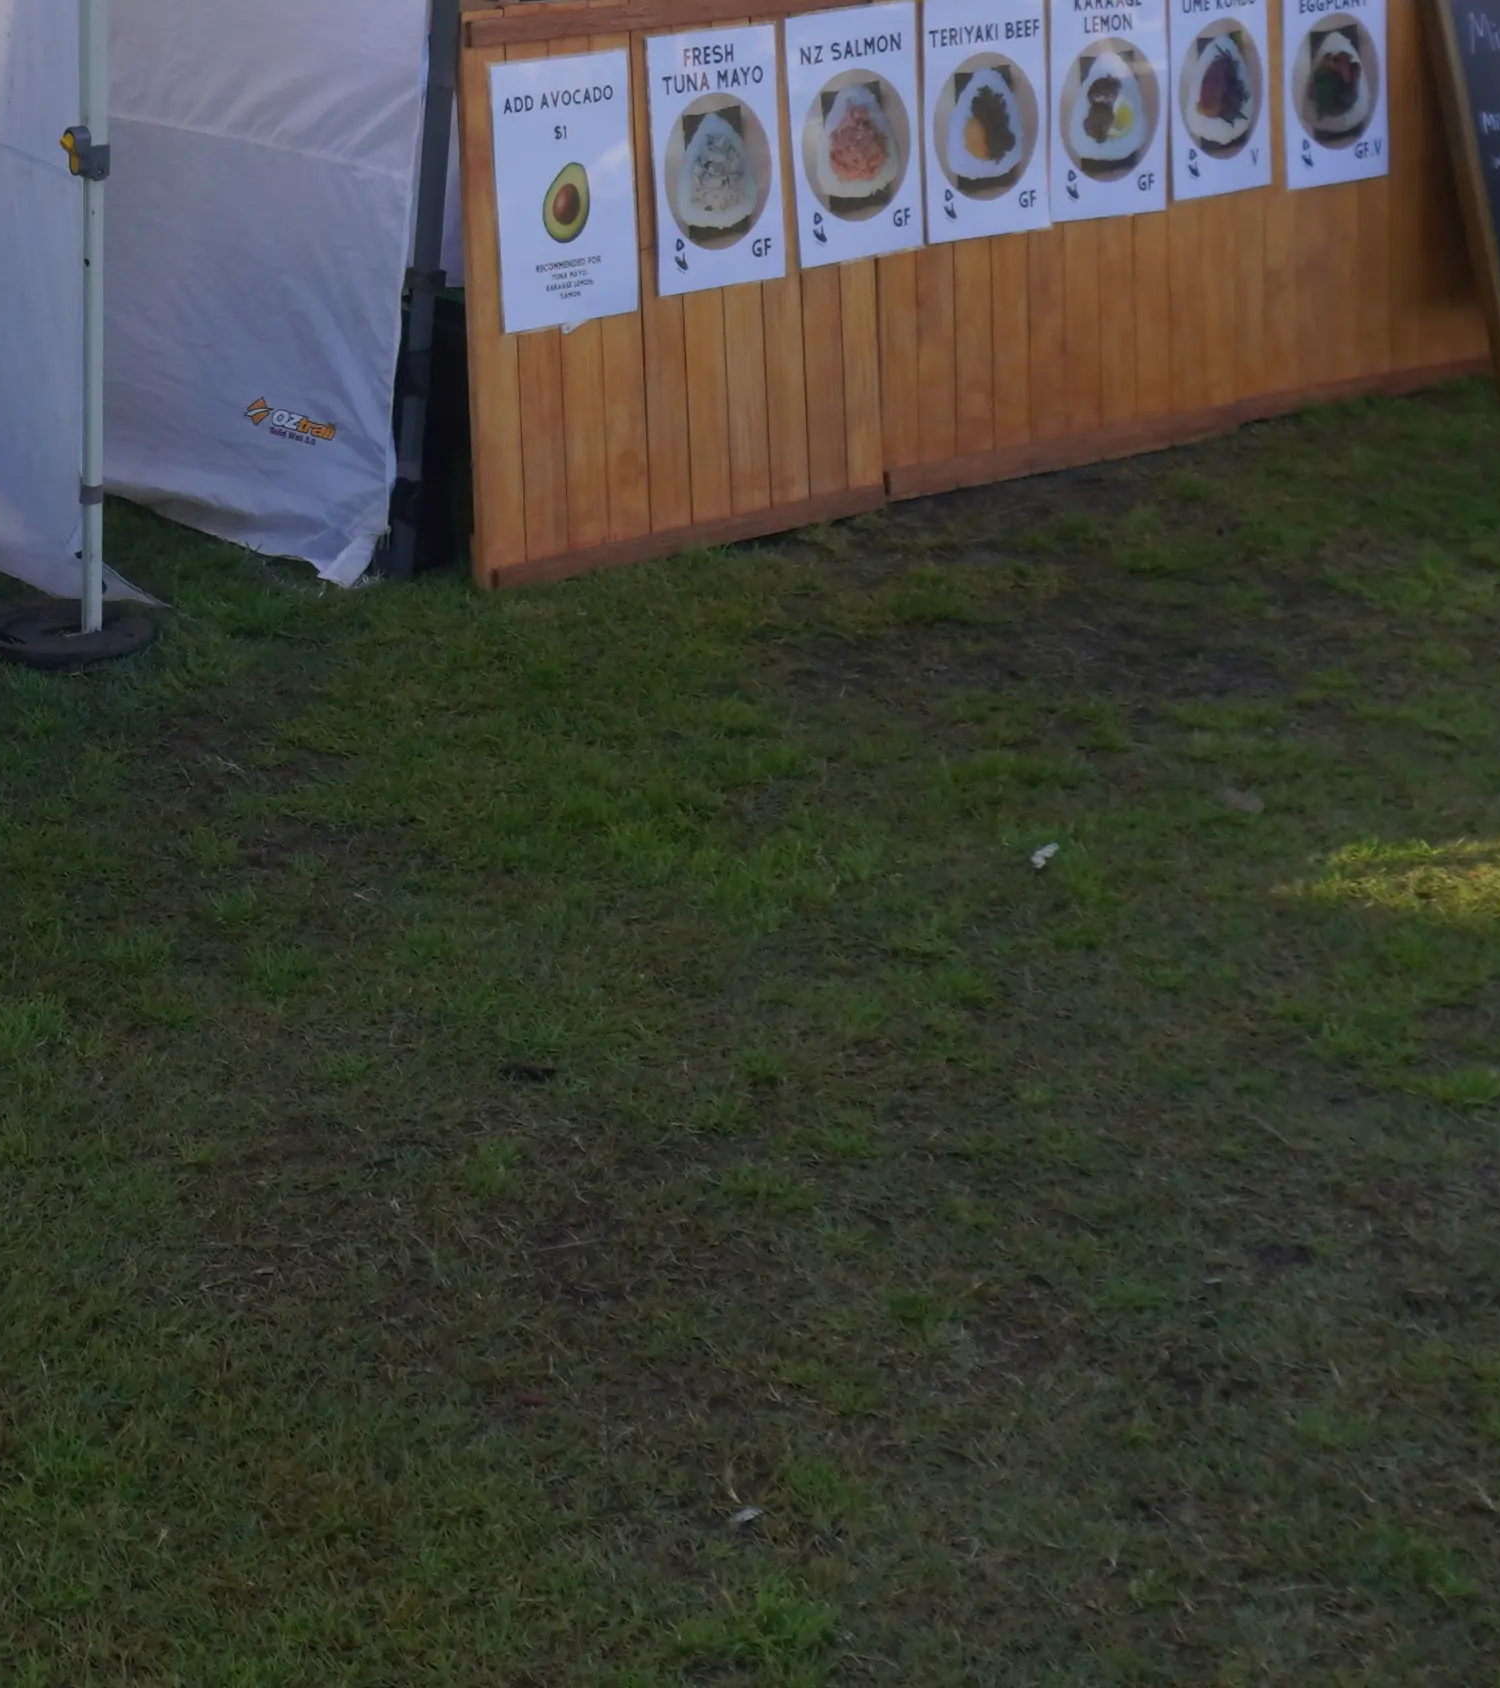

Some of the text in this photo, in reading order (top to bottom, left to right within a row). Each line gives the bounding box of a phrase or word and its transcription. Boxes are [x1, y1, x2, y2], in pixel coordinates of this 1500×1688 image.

[928, 18, 1040, 48] TERIYAKI BEEF
[1084, 13, 1133, 35] LEMON
[683, 43, 735, 68] FRESH
[799, 31, 902, 66] NZ SALMON
[662, 65, 764, 96] TUNA MAYO
[503, 85, 614, 115] ADD AVOCADO
[554, 125, 568, 141] $1
[1250, 149, 1260, 167] V
[1137, 172, 1155, 192] GF
[1018, 189, 1037, 209] GF
[892, 207, 911, 227] GF
[752, 238, 772, 257] GF
[271, 408, 336, 442] OZtrail
